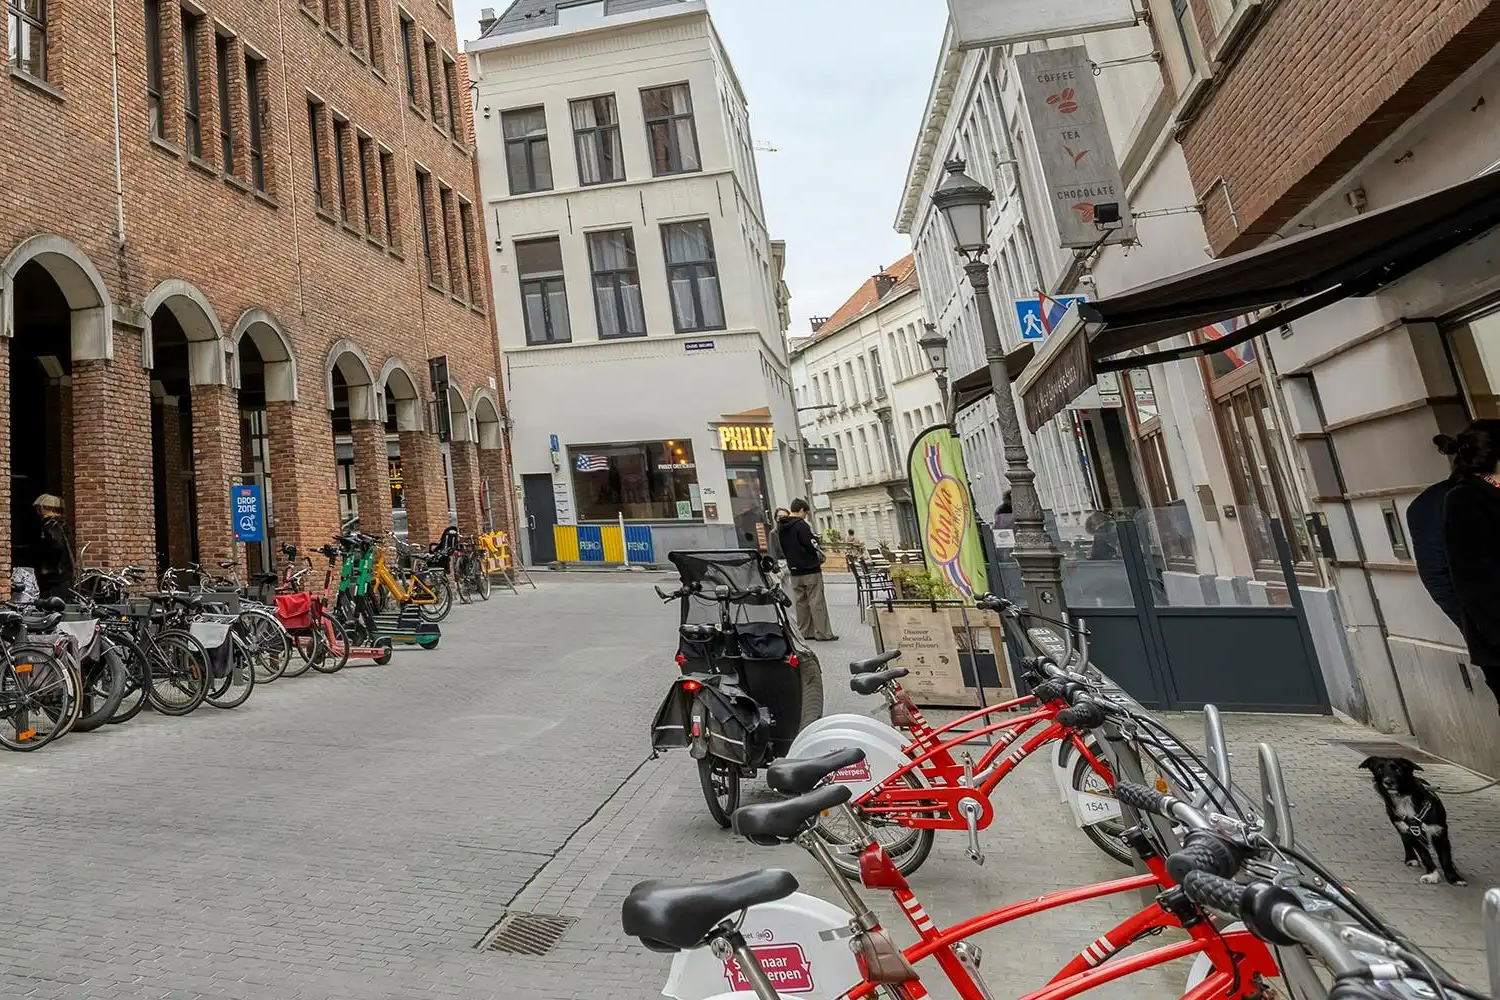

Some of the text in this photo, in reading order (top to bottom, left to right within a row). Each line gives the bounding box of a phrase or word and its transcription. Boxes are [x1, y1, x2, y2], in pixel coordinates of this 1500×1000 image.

[1037, 71, 1075, 83] COFFEE
[1062, 131, 1080, 140] TEA
[1057, 186, 1115, 200] CHOCOLATE
[718, 426, 774, 451] PHILLY
[1086, 802, 1109, 811] 1541
[760, 957, 787, 968] naar
[738, 969, 802, 983] Aerpen
